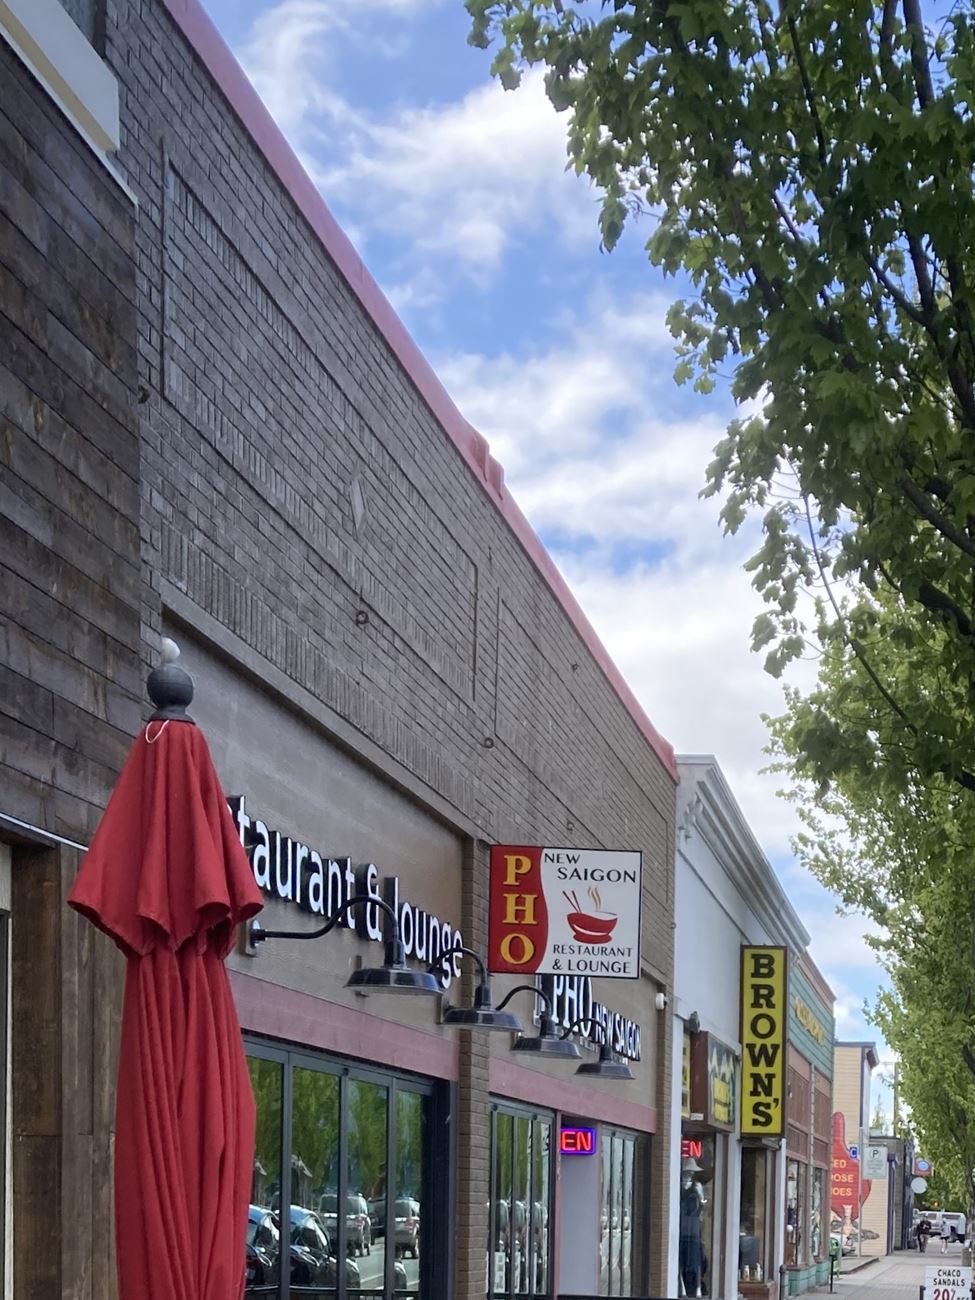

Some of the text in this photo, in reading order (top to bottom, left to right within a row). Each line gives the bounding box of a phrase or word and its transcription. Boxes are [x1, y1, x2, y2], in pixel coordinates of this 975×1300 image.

[544, 852, 581, 864] NEW
[557, 866, 636, 883] SAIGON
[228, 795, 355, 929] taurant
[394, 876, 463, 989] lounge
[500, 855, 538, 965] PHO
[552, 944, 632, 958] RESTAURANT
[552, 958, 631, 974] & LOUNGE
[551, 975, 592, 1038] PHO
[831, 1173, 854, 1183] OSE
[937, 1269, 961, 1278] CHACO
[933, 1278, 966, 1287] SANDALS
